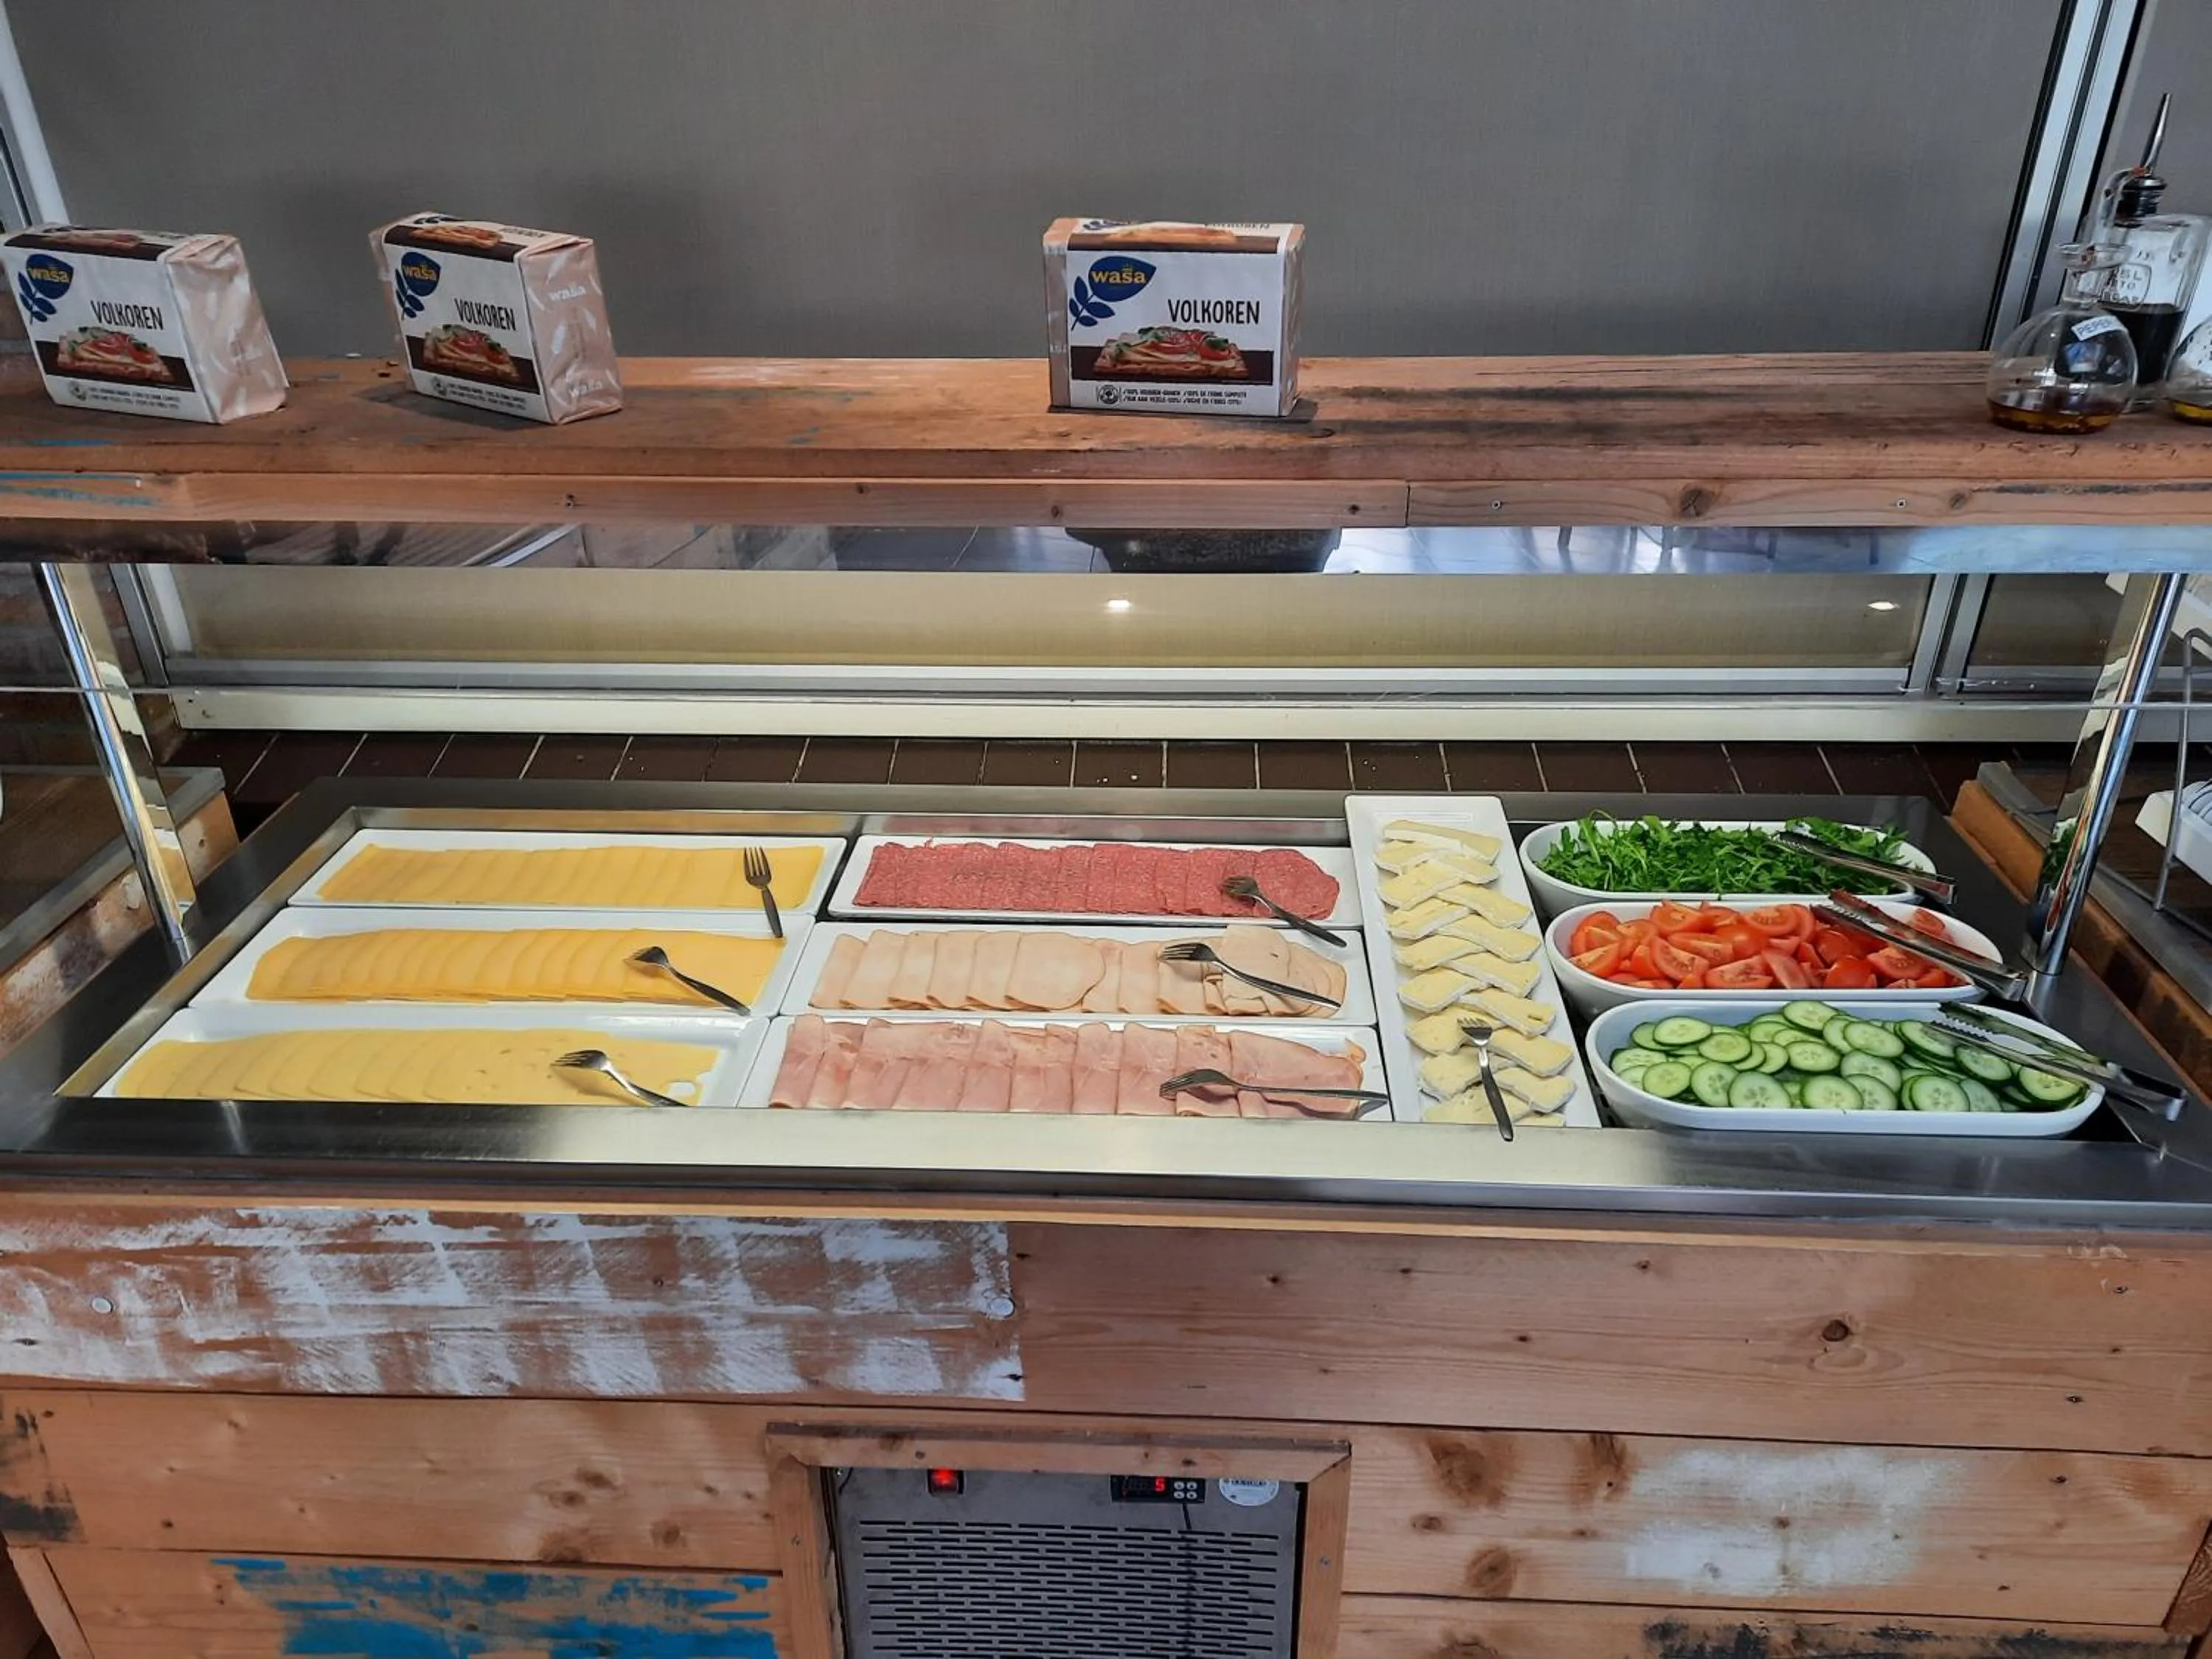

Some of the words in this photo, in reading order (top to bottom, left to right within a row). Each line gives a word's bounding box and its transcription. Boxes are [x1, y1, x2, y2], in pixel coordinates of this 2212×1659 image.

[28, 268, 69, 283] wasa
[403, 265, 437, 281] wasa
[1091, 268, 1147, 284] wasa
[91, 300, 164, 330] VOLKOREN
[454, 298, 516, 331] VOLKOREN
[1168, 299, 1260, 325] VOLKOREN
[1155, 1478, 1165, 1492] 5
